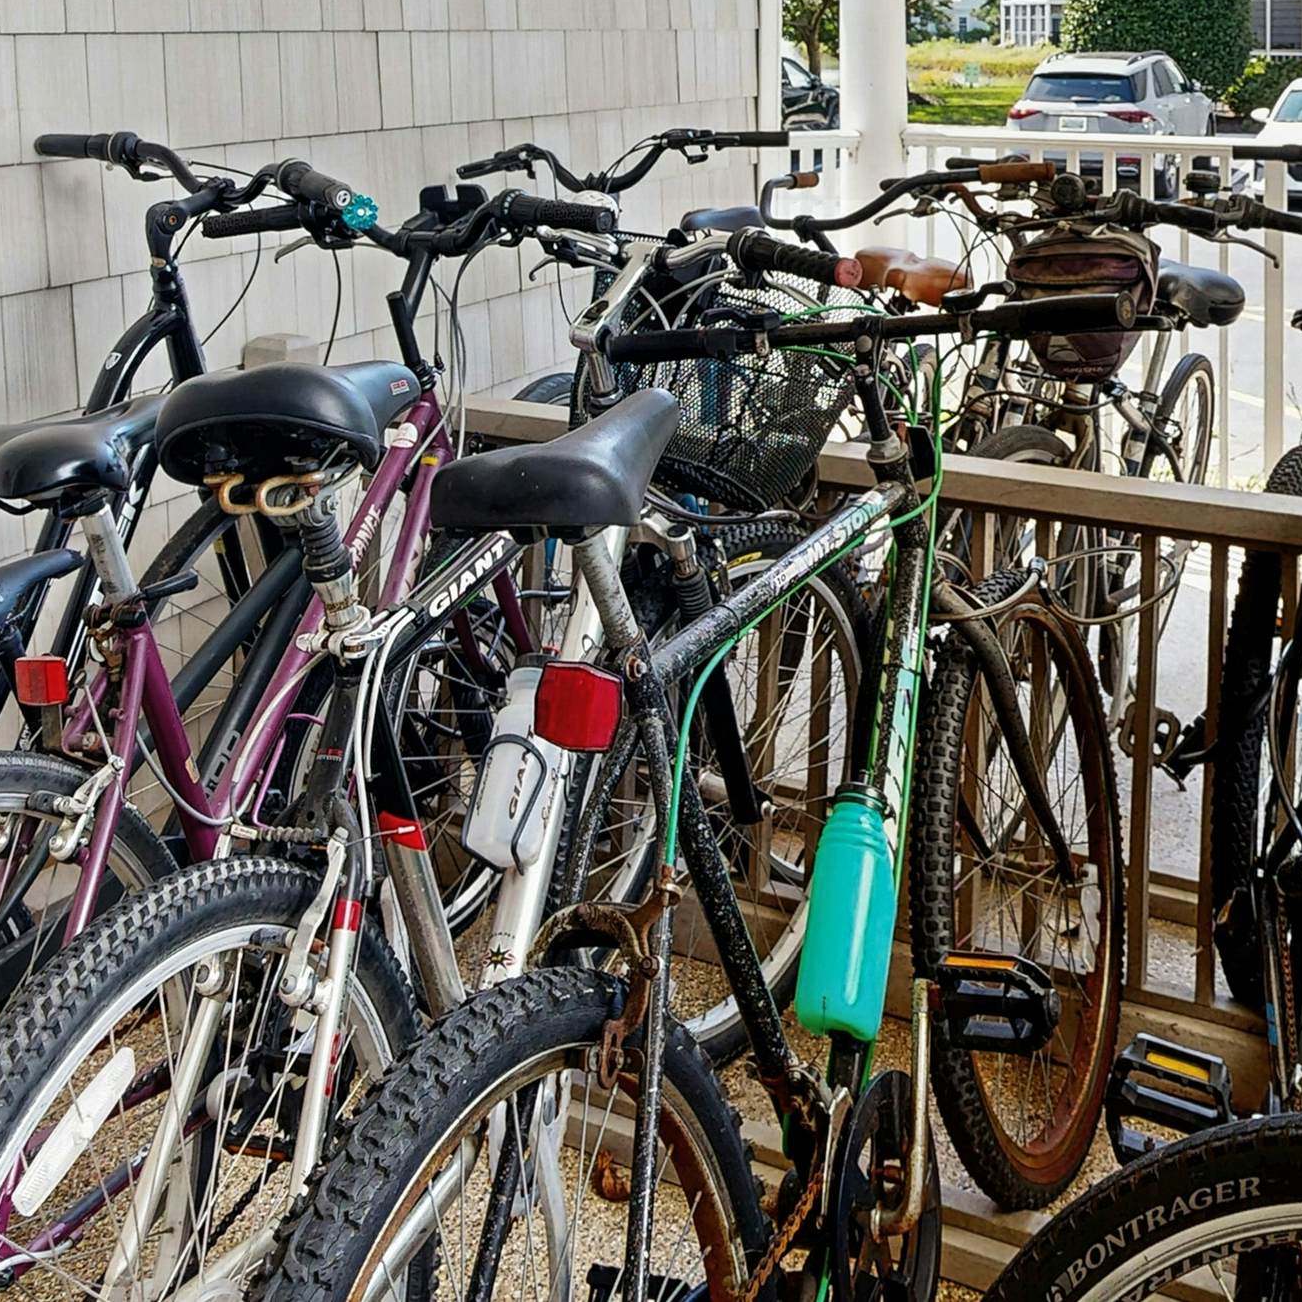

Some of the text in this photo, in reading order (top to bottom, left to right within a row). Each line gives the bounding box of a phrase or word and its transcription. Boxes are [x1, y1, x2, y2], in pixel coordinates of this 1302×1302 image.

[427, 538, 506, 619] GIANT
[508, 724, 534, 820] GIANT
[1066, 1175, 1262, 1289] BONTRAGER
[1118, 1230, 1298, 1302] BONTRA
